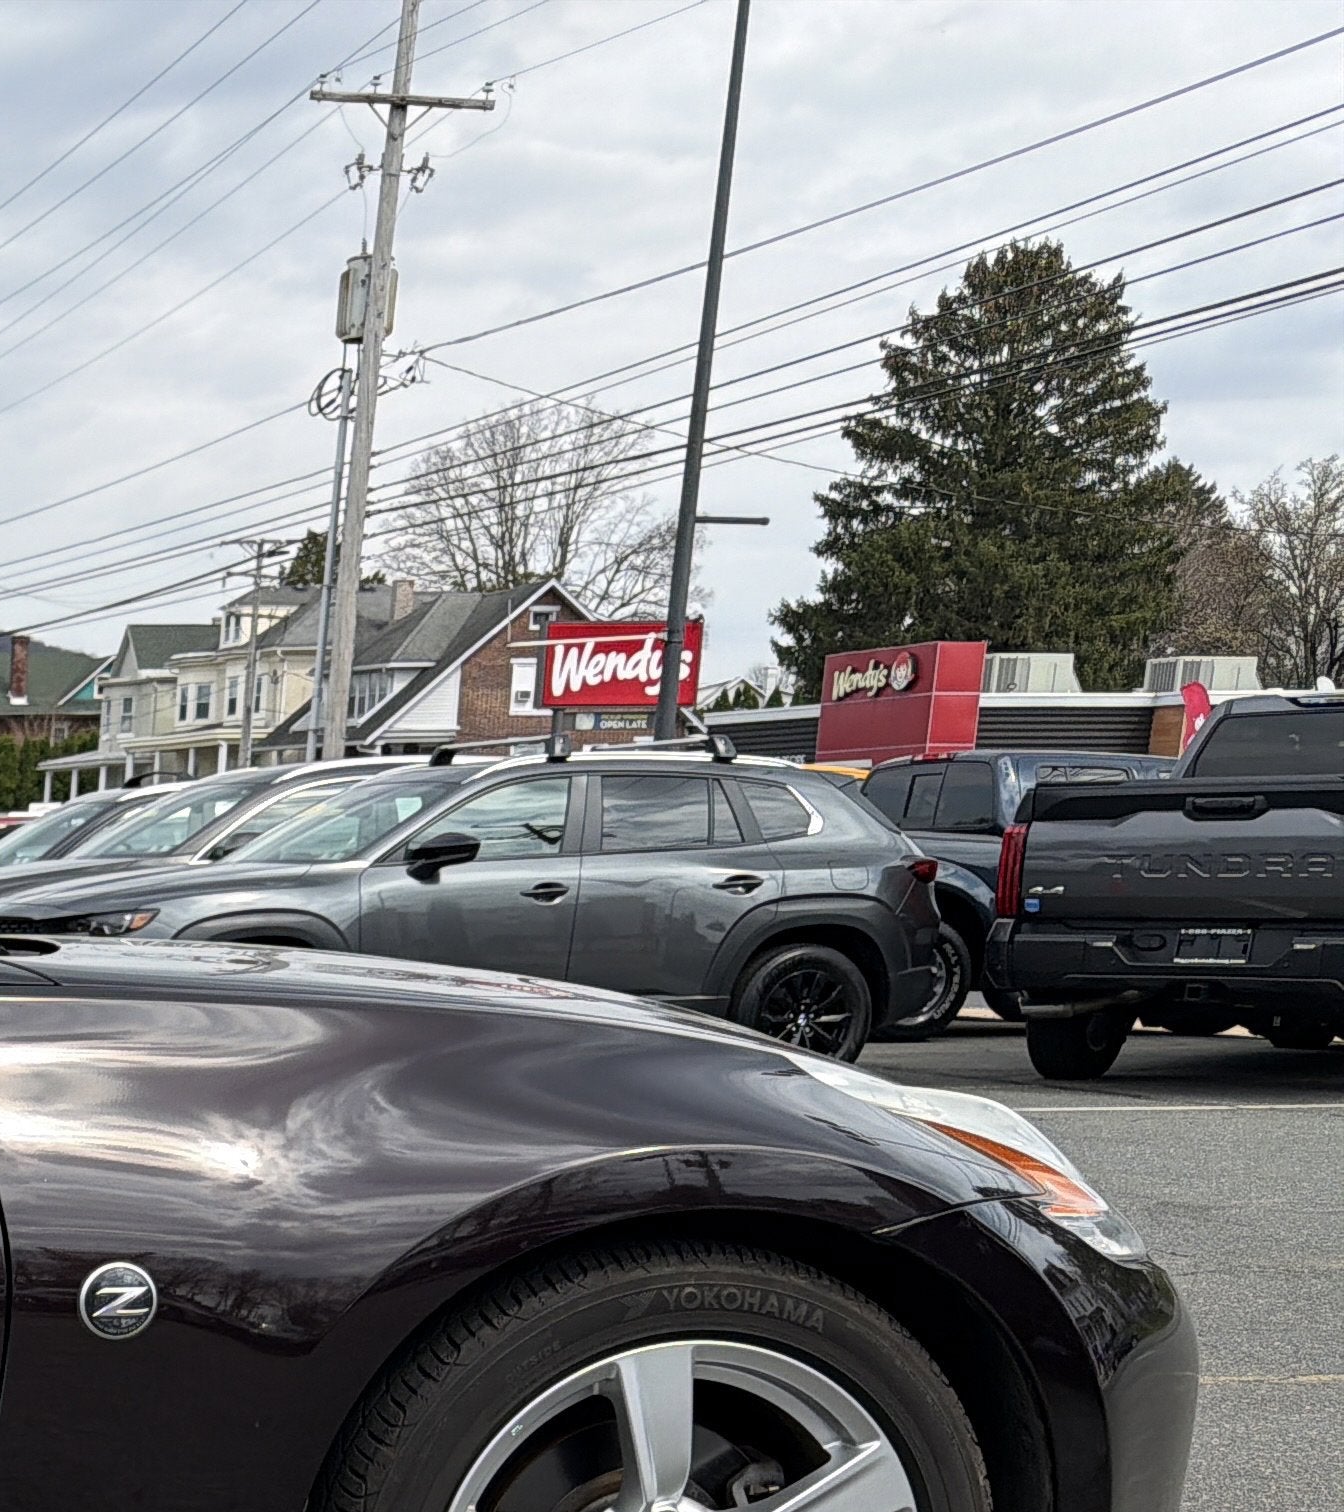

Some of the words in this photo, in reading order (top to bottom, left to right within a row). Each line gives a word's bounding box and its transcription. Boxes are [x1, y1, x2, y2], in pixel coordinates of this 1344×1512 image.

[551, 631, 694, 698] Wendys
[831, 658, 889, 701] Wendy's
[599, 720, 625, 729] OPEN
[625, 720, 648, 729] LATE
[1102, 851, 1336, 879] TUNDRA
[662, 1286, 826, 1335] YOKOHAMA
